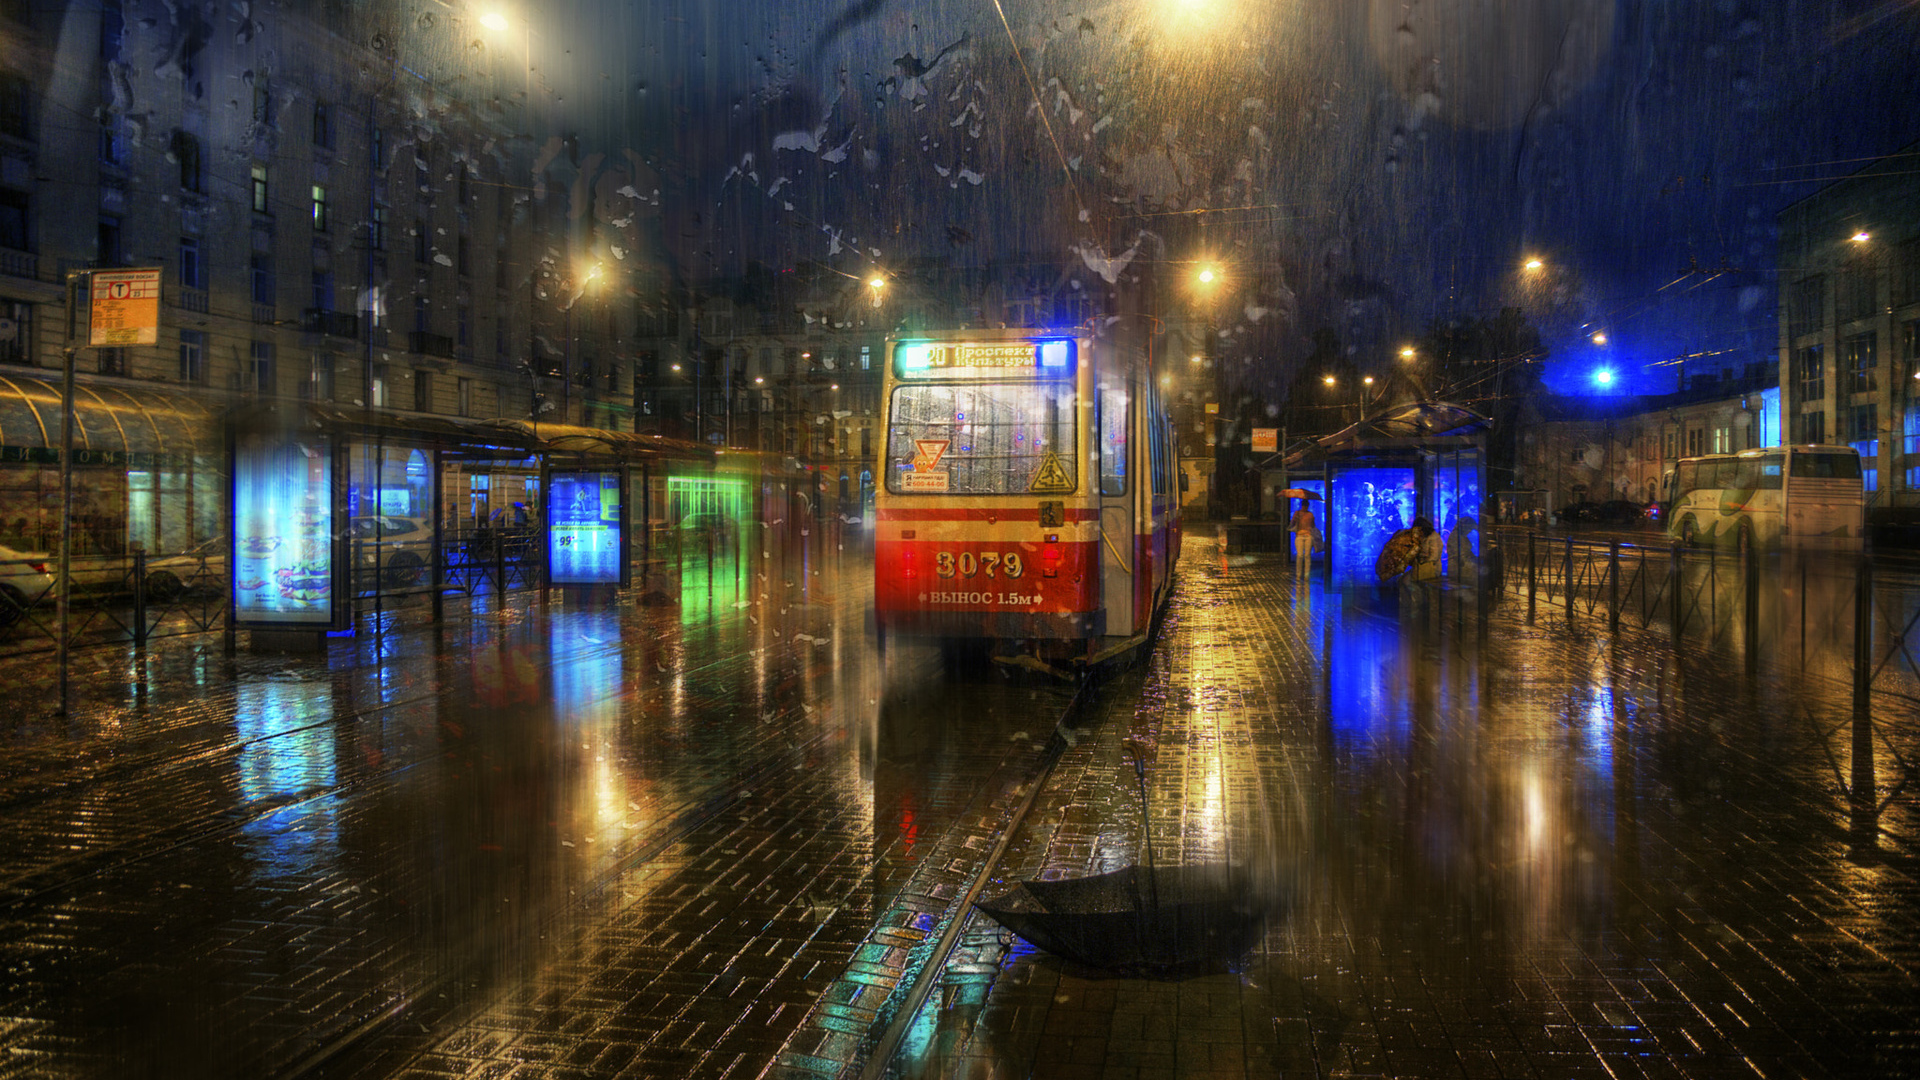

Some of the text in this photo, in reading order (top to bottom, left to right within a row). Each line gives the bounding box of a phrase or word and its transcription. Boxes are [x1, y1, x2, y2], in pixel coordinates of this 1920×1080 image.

[935, 551, 1024, 579] 3079
[929, 591, 1032, 605] ВЫНОС 1.5м
